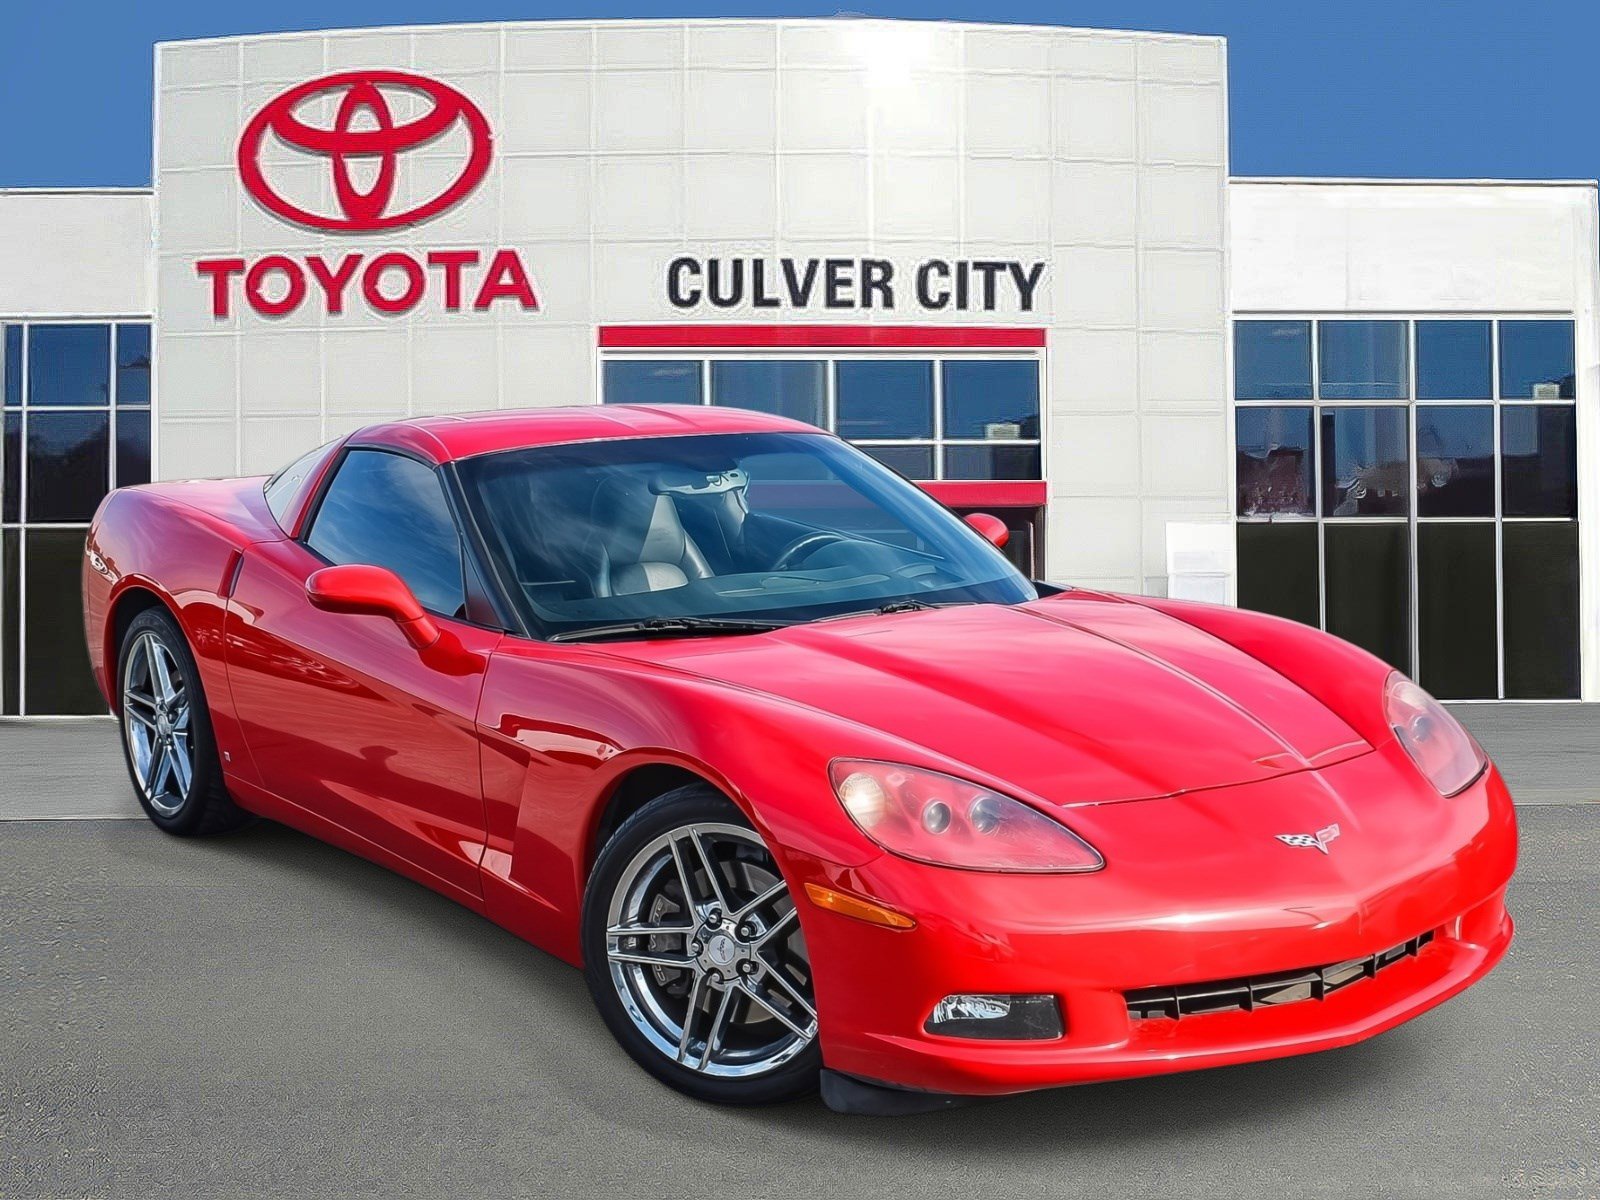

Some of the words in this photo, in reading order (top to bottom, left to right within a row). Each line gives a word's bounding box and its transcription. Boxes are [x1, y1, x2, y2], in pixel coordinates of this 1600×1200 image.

[196, 249, 538, 317] TOYOTA
[668, 256, 895, 309] CULVER
[915, 260, 1045, 311] CITY
